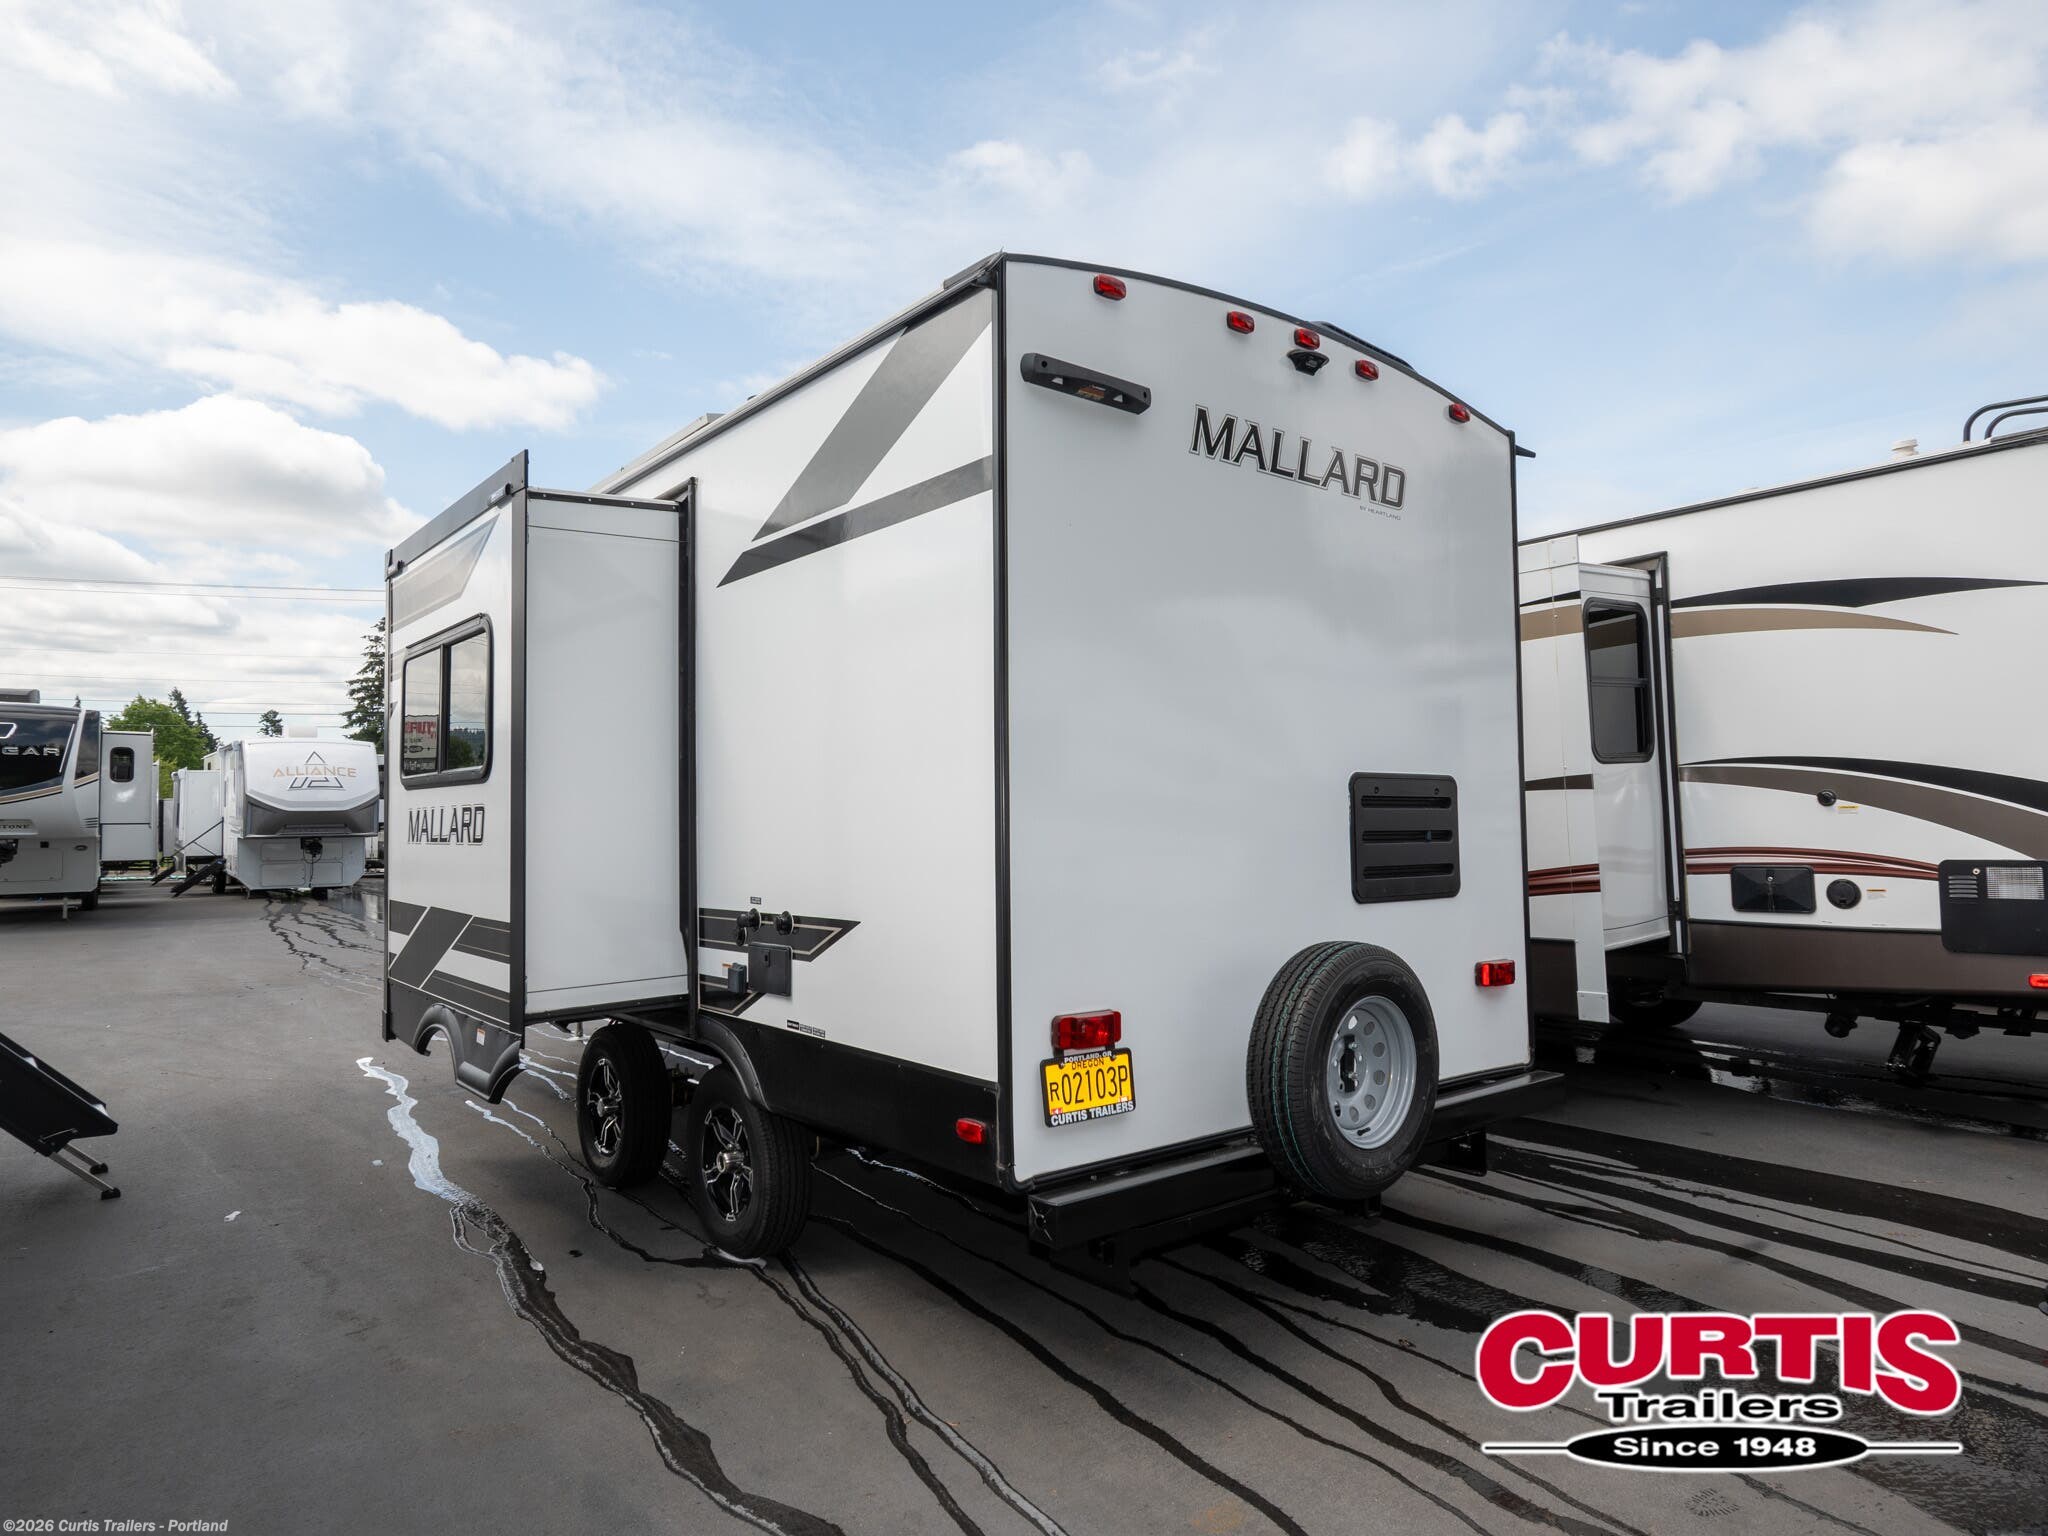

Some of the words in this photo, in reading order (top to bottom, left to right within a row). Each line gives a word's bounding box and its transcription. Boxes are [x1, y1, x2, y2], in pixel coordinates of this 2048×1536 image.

[1189, 403, 1406, 510] MALLARD
[273, 765, 357, 778] ALLIANCE
[407, 803, 485, 846] MALLARD
[1071, 1058, 1105, 1070] OREGON
[1102, 1050, 1113, 1059] OR
[1049, 1065, 1128, 1106] R02103P
[1050, 1109, 1088, 1126] CURTIS
[1088, 1100, 1134, 1119] TRAILERS
